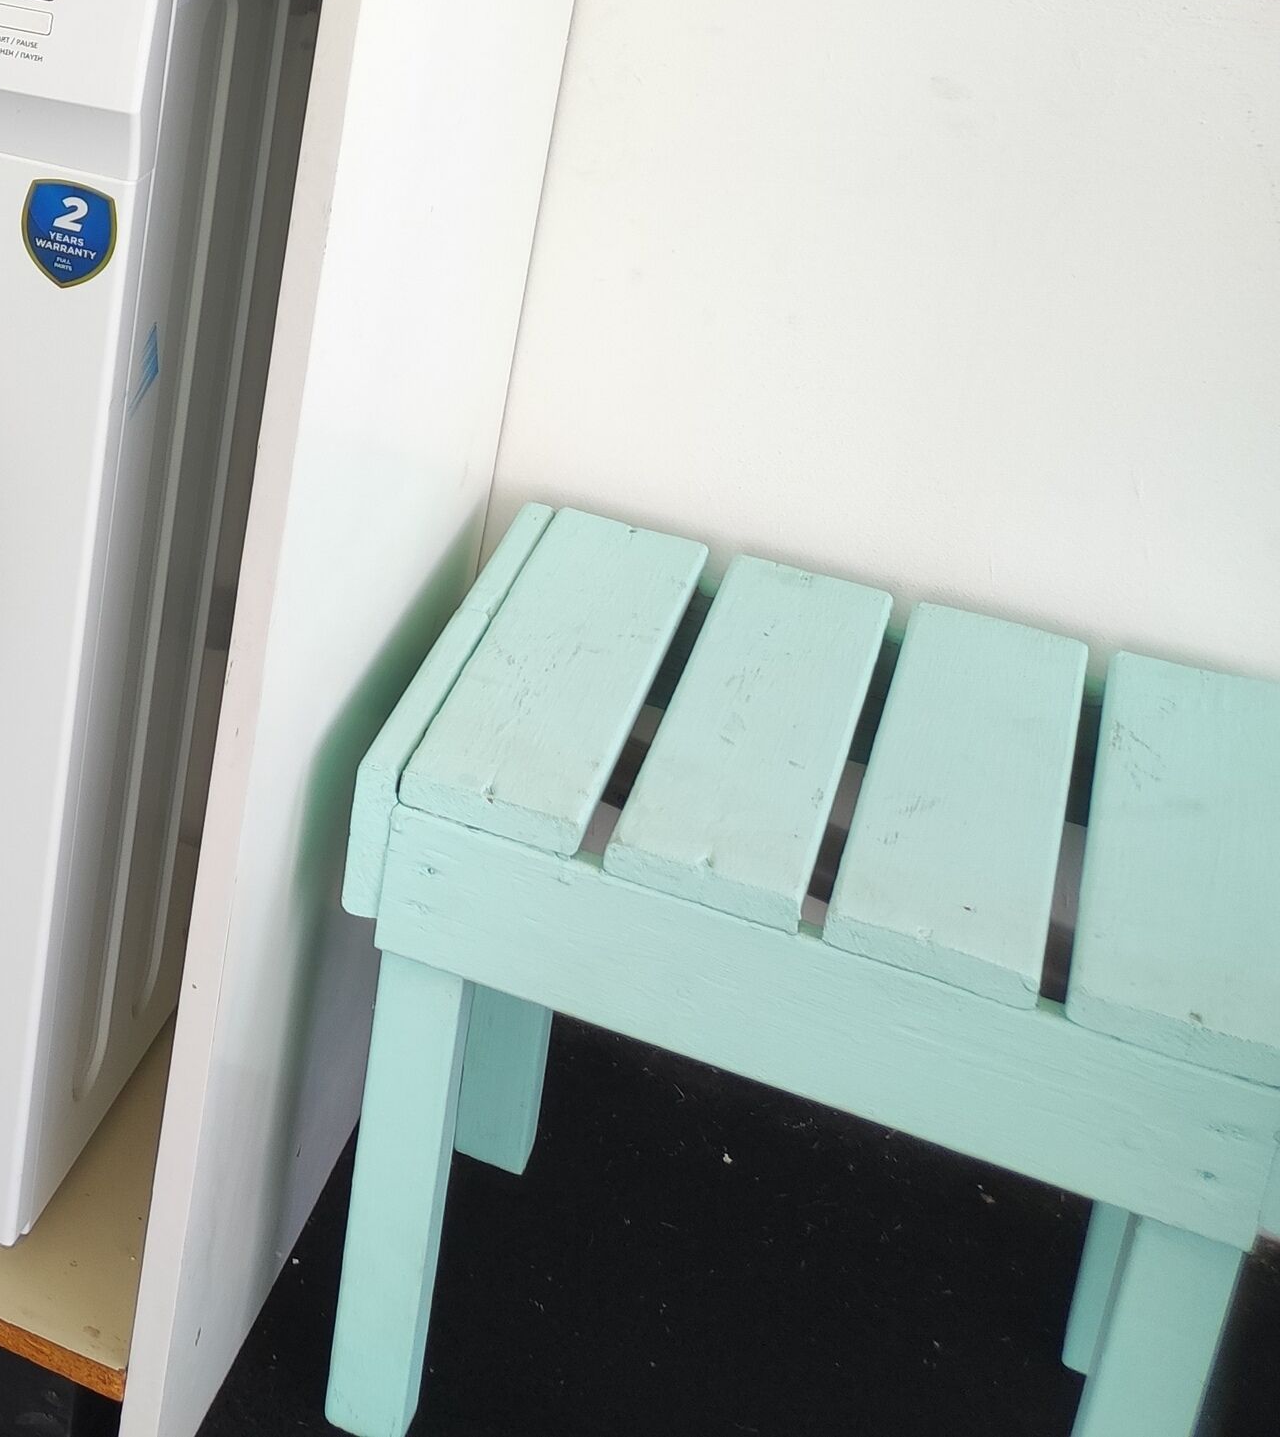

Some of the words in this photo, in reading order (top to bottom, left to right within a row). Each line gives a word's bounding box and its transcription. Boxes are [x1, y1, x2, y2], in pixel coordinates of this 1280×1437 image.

[16, 38, 38, 49] PAUSE
[52, 196, 89, 232] 2
[49, 230, 85, 247] YEARS
[35, 237, 97, 260] WARRANTY
[56, 256, 72, 265] FULL
